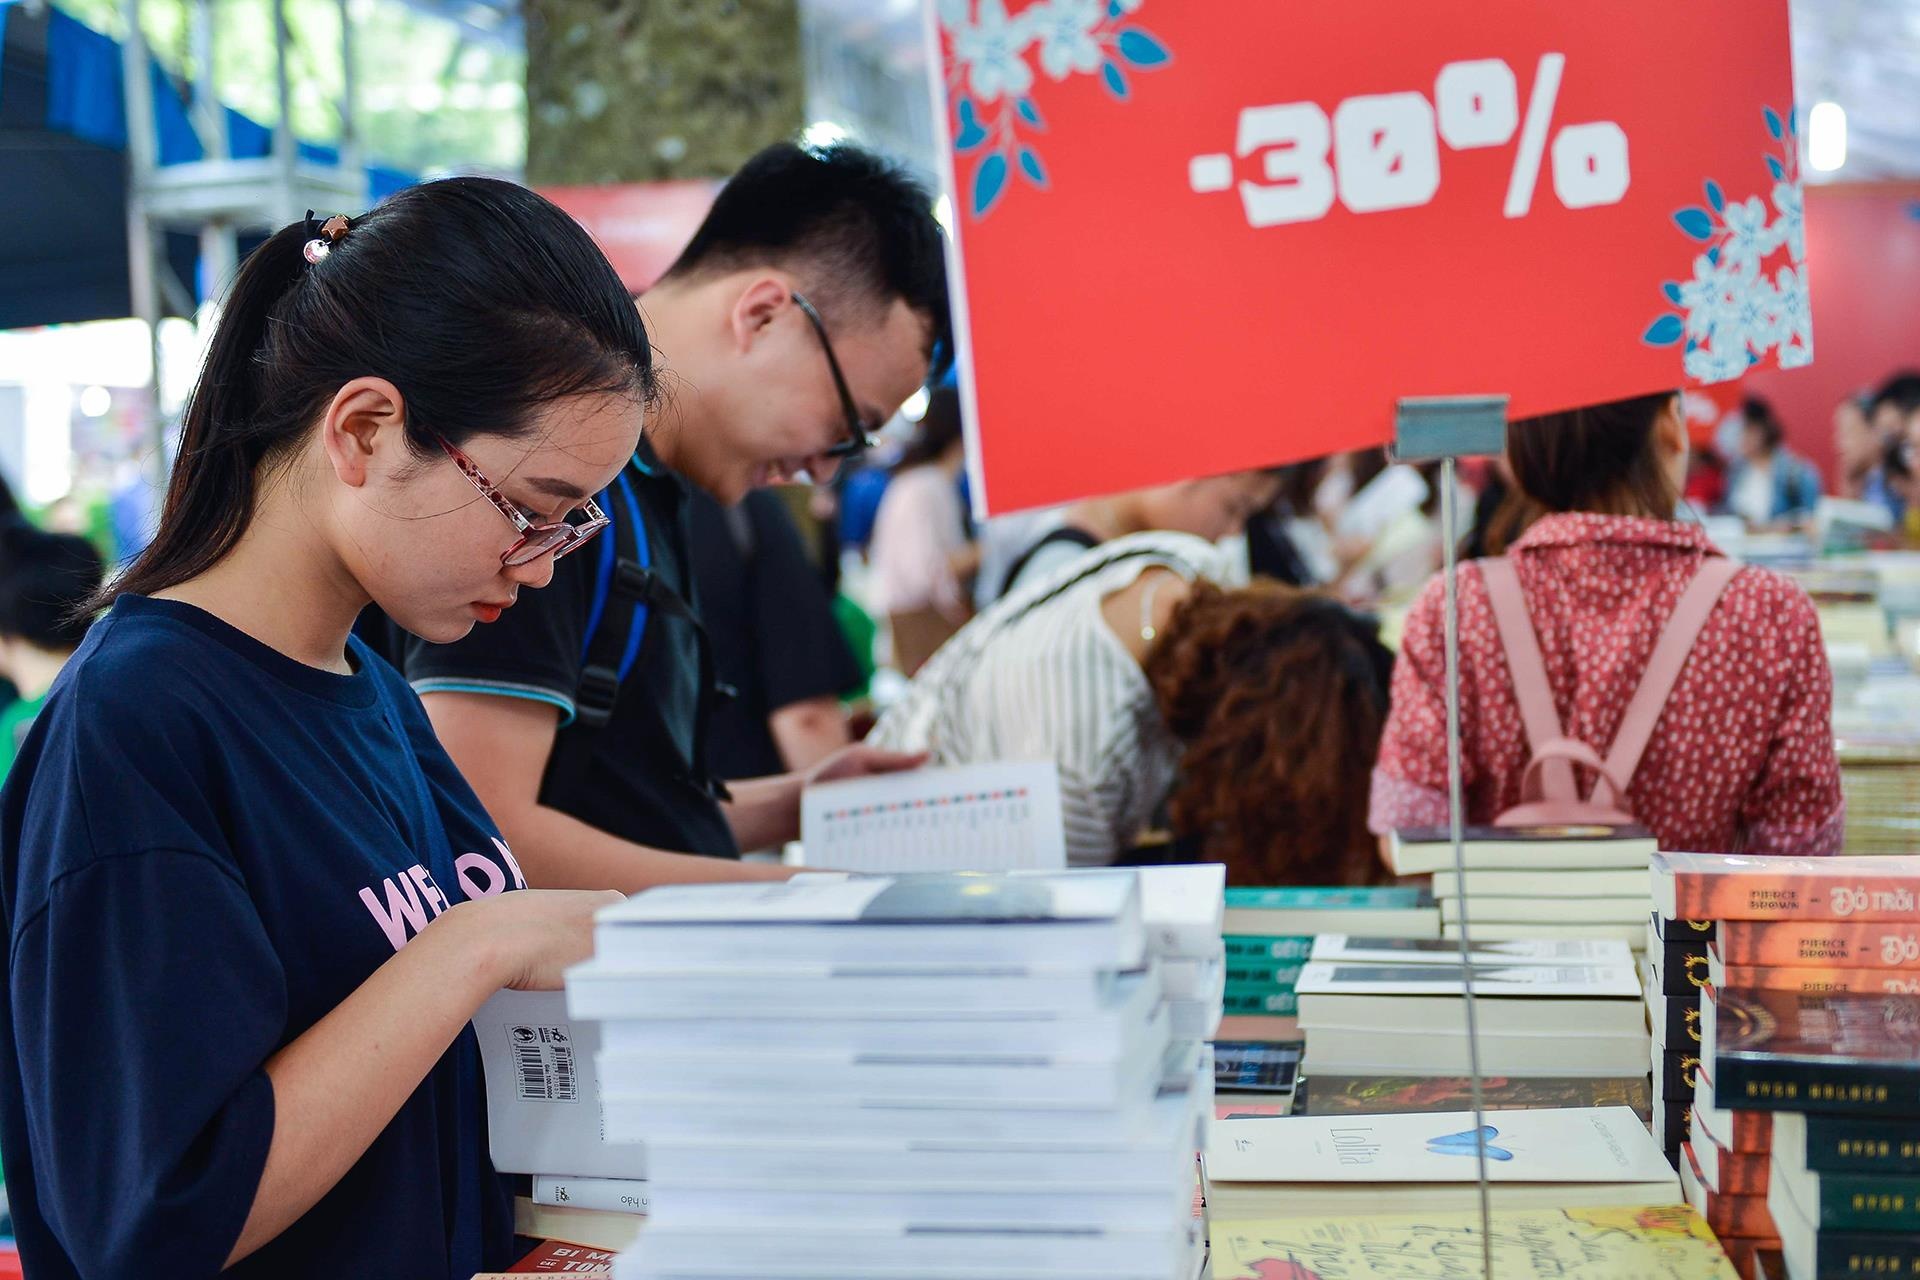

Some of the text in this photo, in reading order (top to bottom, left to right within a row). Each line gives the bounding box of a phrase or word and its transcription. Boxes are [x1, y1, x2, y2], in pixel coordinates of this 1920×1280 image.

[1189, 52, 1631, 228] -30%
[1751, 890, 1798, 900] PIERCE
[1750, 900, 1800, 910] BROWN
[1799, 949, 1849, 959] BROWN
[1330, 1127, 1382, 1165] Lolita
